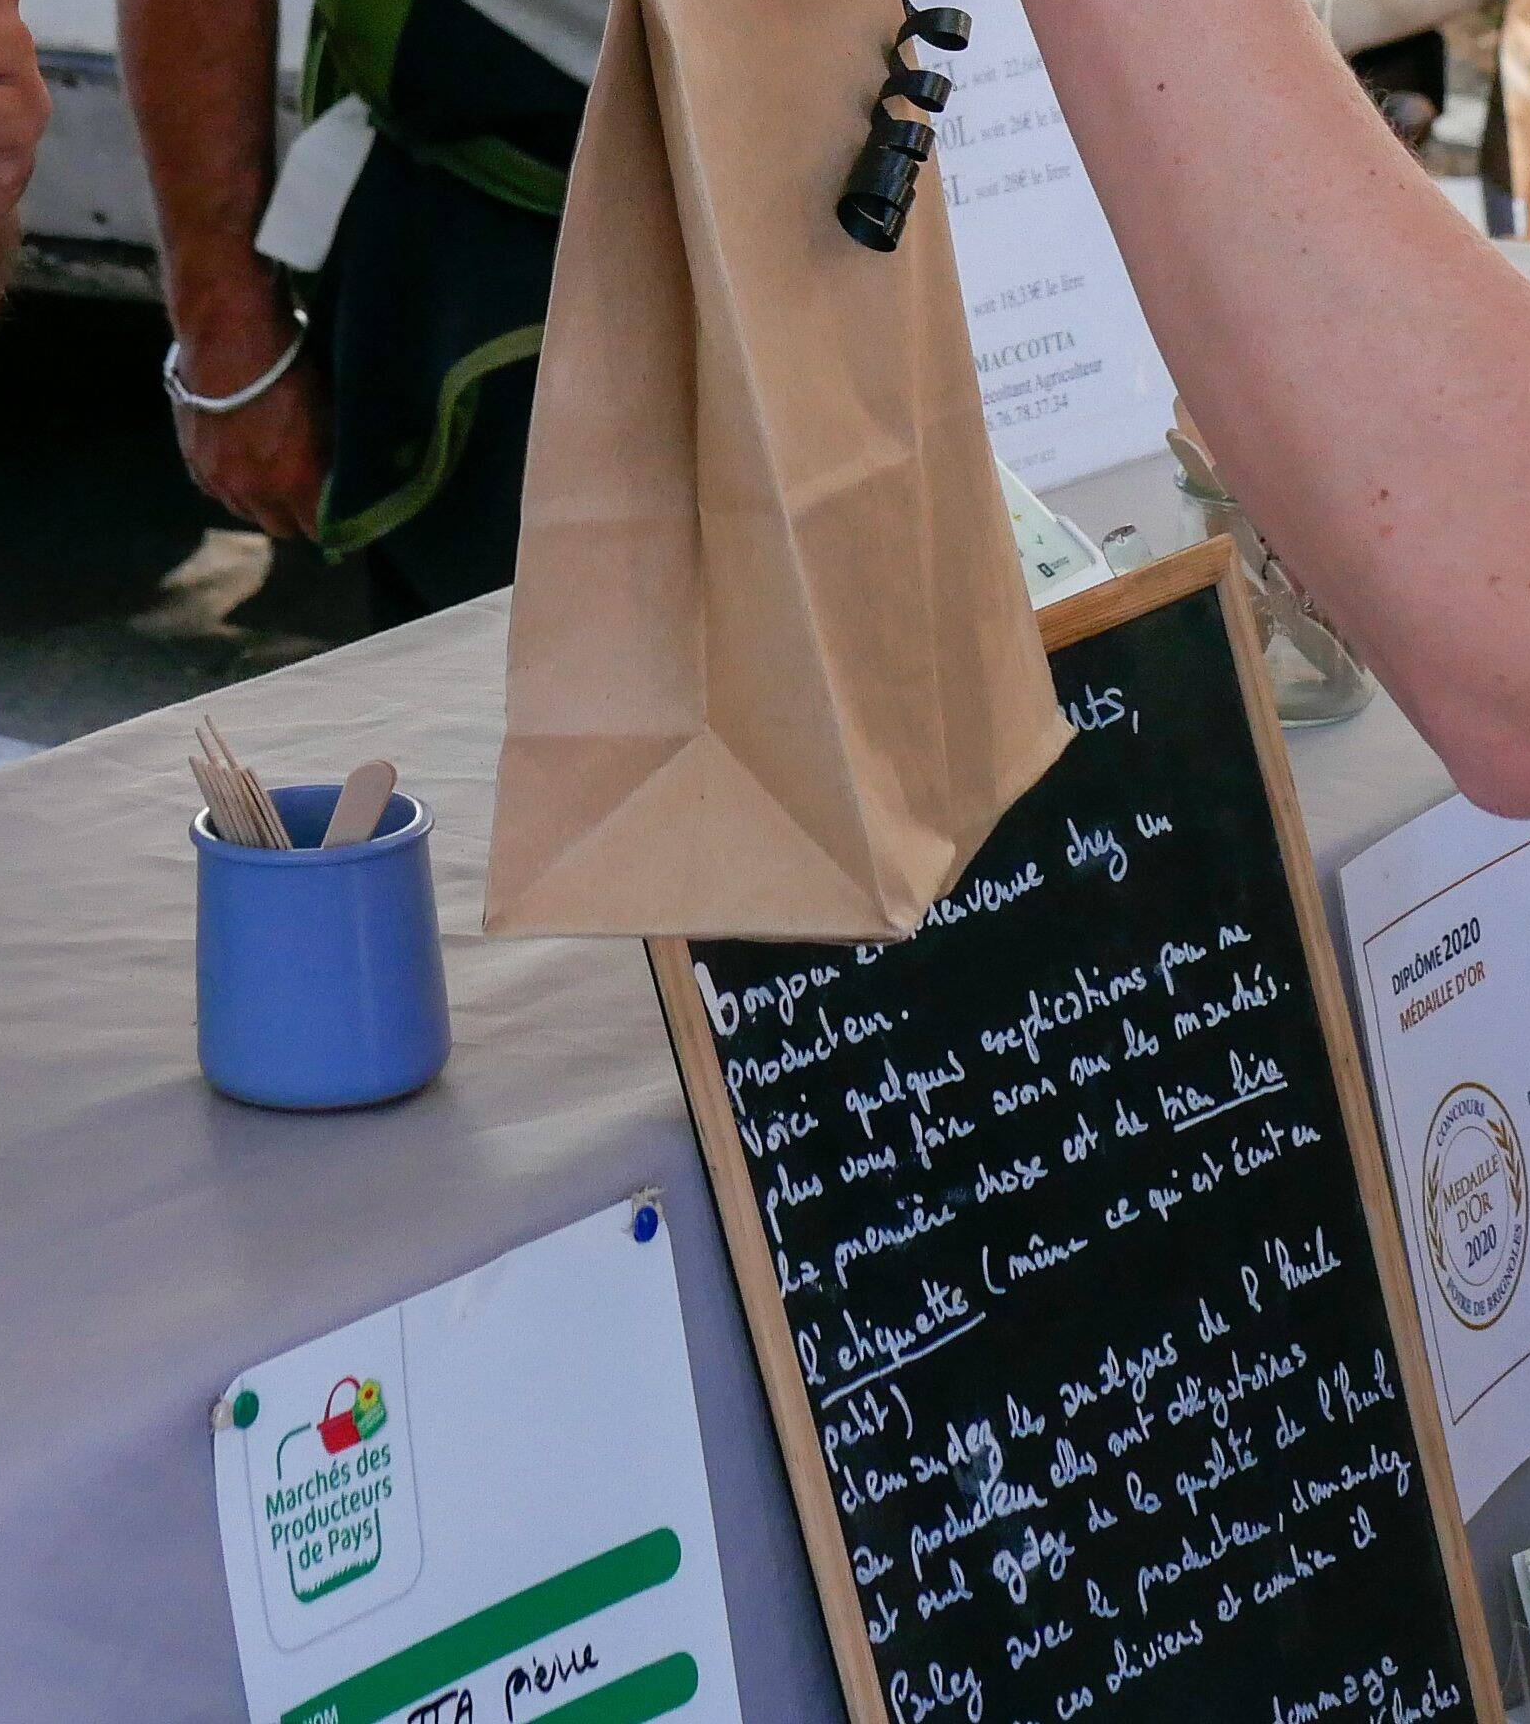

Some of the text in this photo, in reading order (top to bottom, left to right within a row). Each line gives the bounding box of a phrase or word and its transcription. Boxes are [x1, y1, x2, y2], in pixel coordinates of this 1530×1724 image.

[1066, 817, 1128, 883] chez
[1135, 812, 1173, 839] un
[1391, 916, 1481, 996] DIPLÔME 2020
[1399, 960, 1486, 1034] MÉDAILLE D'OR
[845, 1049, 965, 1140] quelques
[980, 966, 1148, 1065] explications
[1159, 941, 1207, 996] pour
[765, 1162, 824, 1244] plus
[839, 1144, 897, 1185] vous
[909, 1111, 976, 1170] faire
[1069, 1053, 1112, 1088] sur
[1122, 1017, 1160, 1061] les
[1435, 1098, 1486, 1147] CONCOURS
[776, 1249, 821, 1299] la
[974, 1155, 1049, 1204] chose
[1063, 1112, 1099, 1163] est
[1115, 1098, 1149, 1138] de
[1157, 1084, 1216, 1122] bien
[1105, 1197, 1141, 1230] ce
[1148, 1169, 1183, 1222] qui
[1191, 1151, 1224, 1193] est
[1231, 1120, 1285, 1177] écrit
[1290, 1124, 1322, 1148] en
[1442, 1153, 1500, 1213] MEDAILLE
[1456, 1191, 1494, 1233] D'OR
[1465, 1223, 1497, 1269] 2020
[823, 1383, 914, 1474] petit)
[841, 1418, 1004, 1515] demandez
[1005, 1392, 1046, 1440] les
[1058, 1331, 1179, 1419] analyses
[1197, 1296, 1231, 1344] de
[265, 1443, 391, 1520] Marchés des
[852, 1544, 895, 1586] au
[910, 1476, 1050, 1583] producteur
[1049, 1436, 1099, 1489] elles
[1168, 1342, 1308, 1429] obligatoires
[271, 1474, 393, 1552] Producteurs
[298, 1517, 373, 1571] de Pays
[868, 1592, 899, 1645] et
[992, 1525, 1076, 1606] gage
[1087, 1497, 1119, 1534] de
[1126, 1470, 1162, 1515] la
[1175, 1426, 1259, 1517] qualité
[1275, 1404, 1307, 1451] de
[1005, 1620, 1074, 1671] avec
[1085, 1577, 1121, 1619] le
[1291, 1443, 1412, 1514] demandez
[1105, 1618, 1206, 1695] oliviers
[1216, 1582, 1243, 1623] et
[1252, 1543, 1338, 1606] combien
[1348, 1503, 1378, 1550] il
